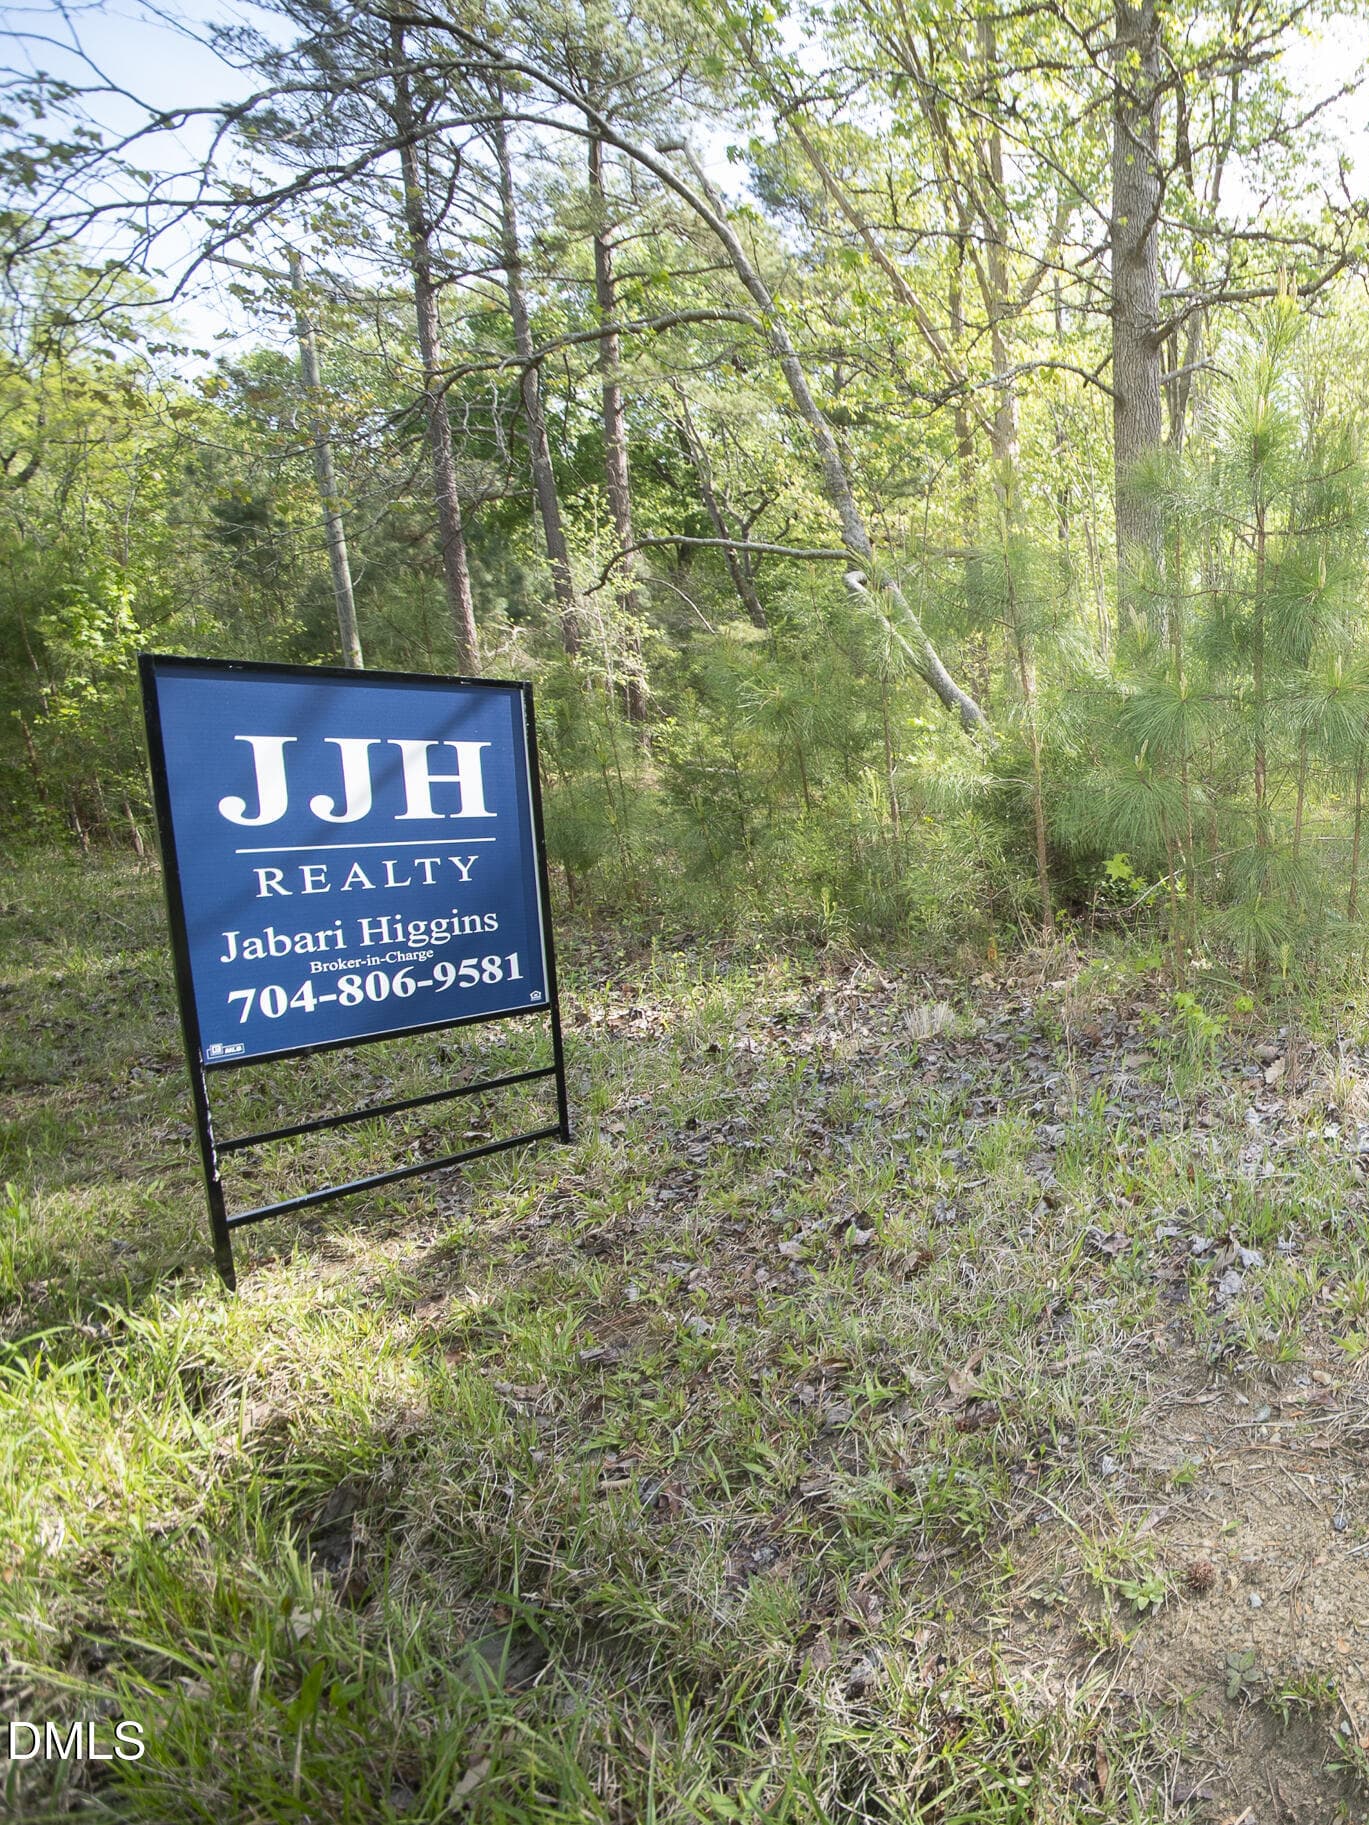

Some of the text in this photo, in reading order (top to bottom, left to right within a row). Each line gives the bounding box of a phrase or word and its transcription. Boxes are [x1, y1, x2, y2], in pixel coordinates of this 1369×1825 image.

[218, 735, 497, 826] JJH
[254, 855, 479, 898] REALTY
[220, 910, 499, 964] Jabari Higgins
[310, 948, 434, 974] Broker-in-Charge
[227, 952, 525, 1024] 704-806-9581
